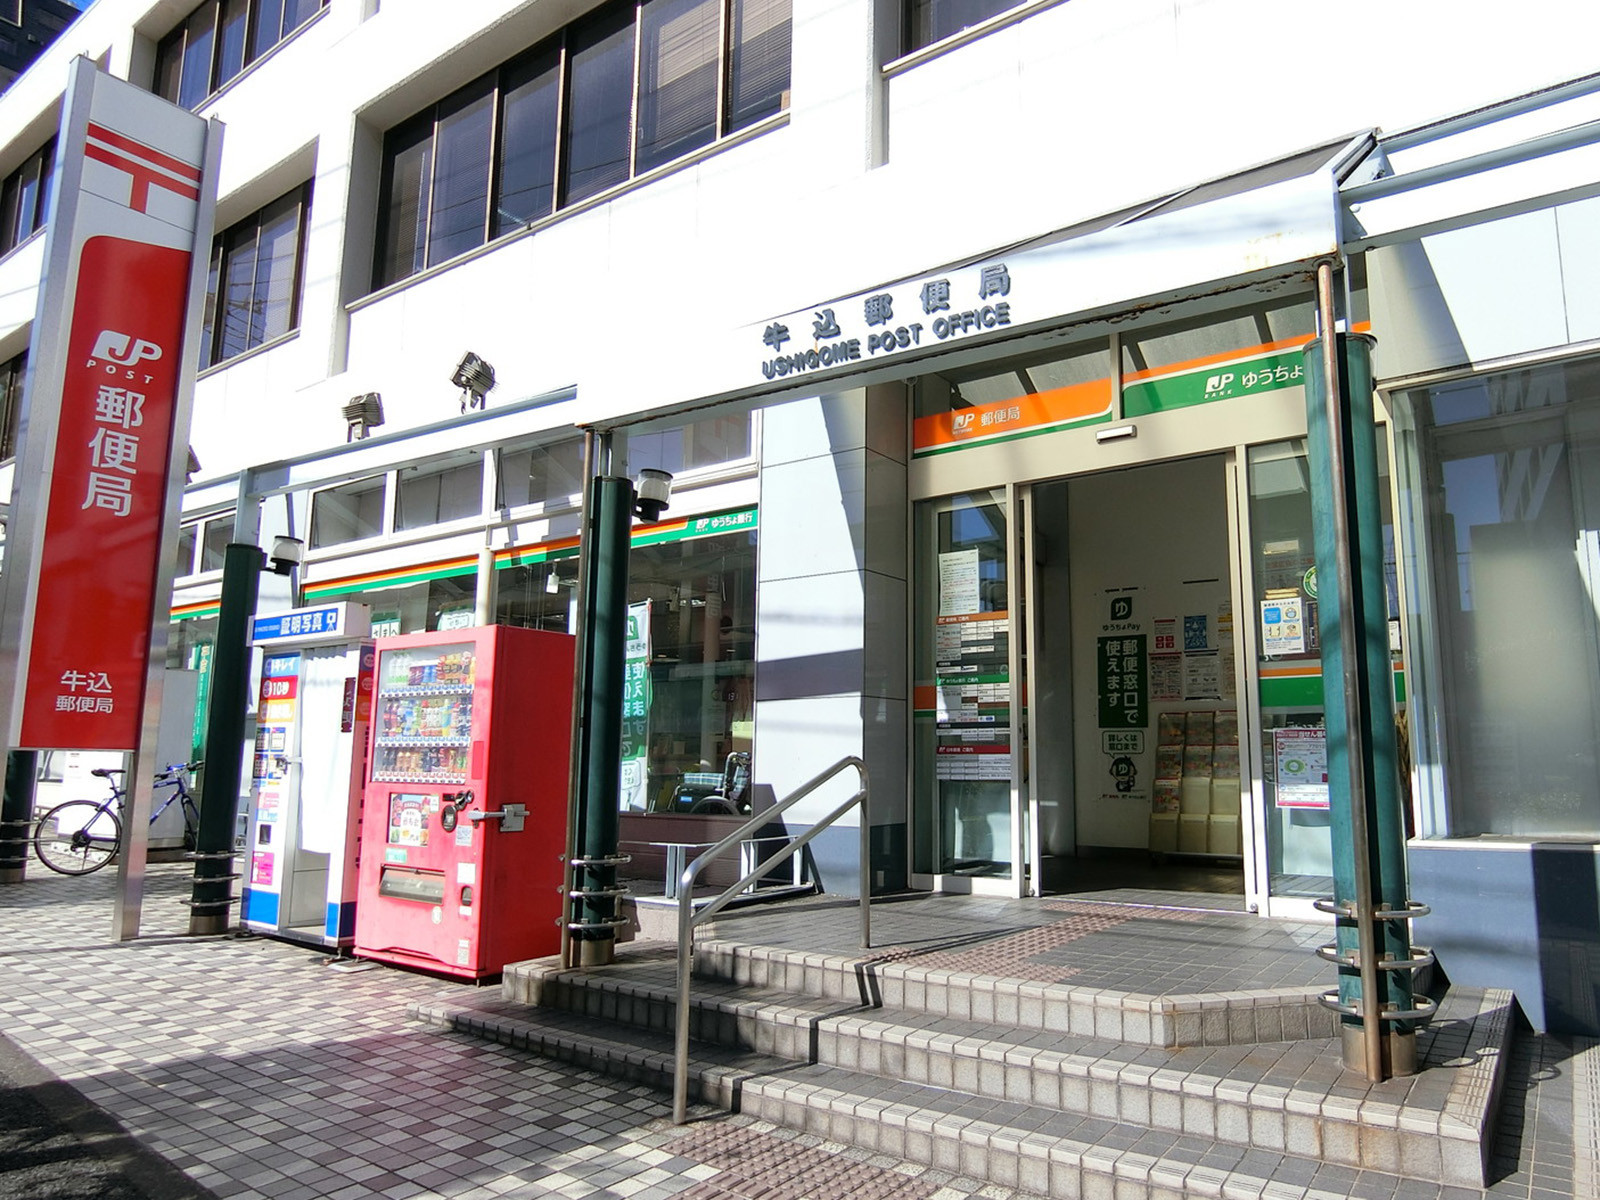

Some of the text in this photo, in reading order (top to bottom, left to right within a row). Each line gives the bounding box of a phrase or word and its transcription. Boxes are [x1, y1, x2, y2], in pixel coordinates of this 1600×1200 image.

[762, 263, 1012, 352] 牛込郵便局
[762, 302, 1011, 380] USHIGOME POST OFFICE
[86, 359, 154, 384] POST
[1241, 364, 1304, 389] ゆうちょ
[980, 406, 1020, 427] 郵便局
[81, 384, 146, 518] 郵便局
[711, 511, 753, 529] ゆうちょ銀行
[280, 612, 324, 636] 証明写真
[60, 670, 113, 694] 牛込
[1105, 640, 1121, 708] 使えます
[1121, 638, 1140, 724] 郵便窓口で
[55, 695, 114, 714] 郵便局
